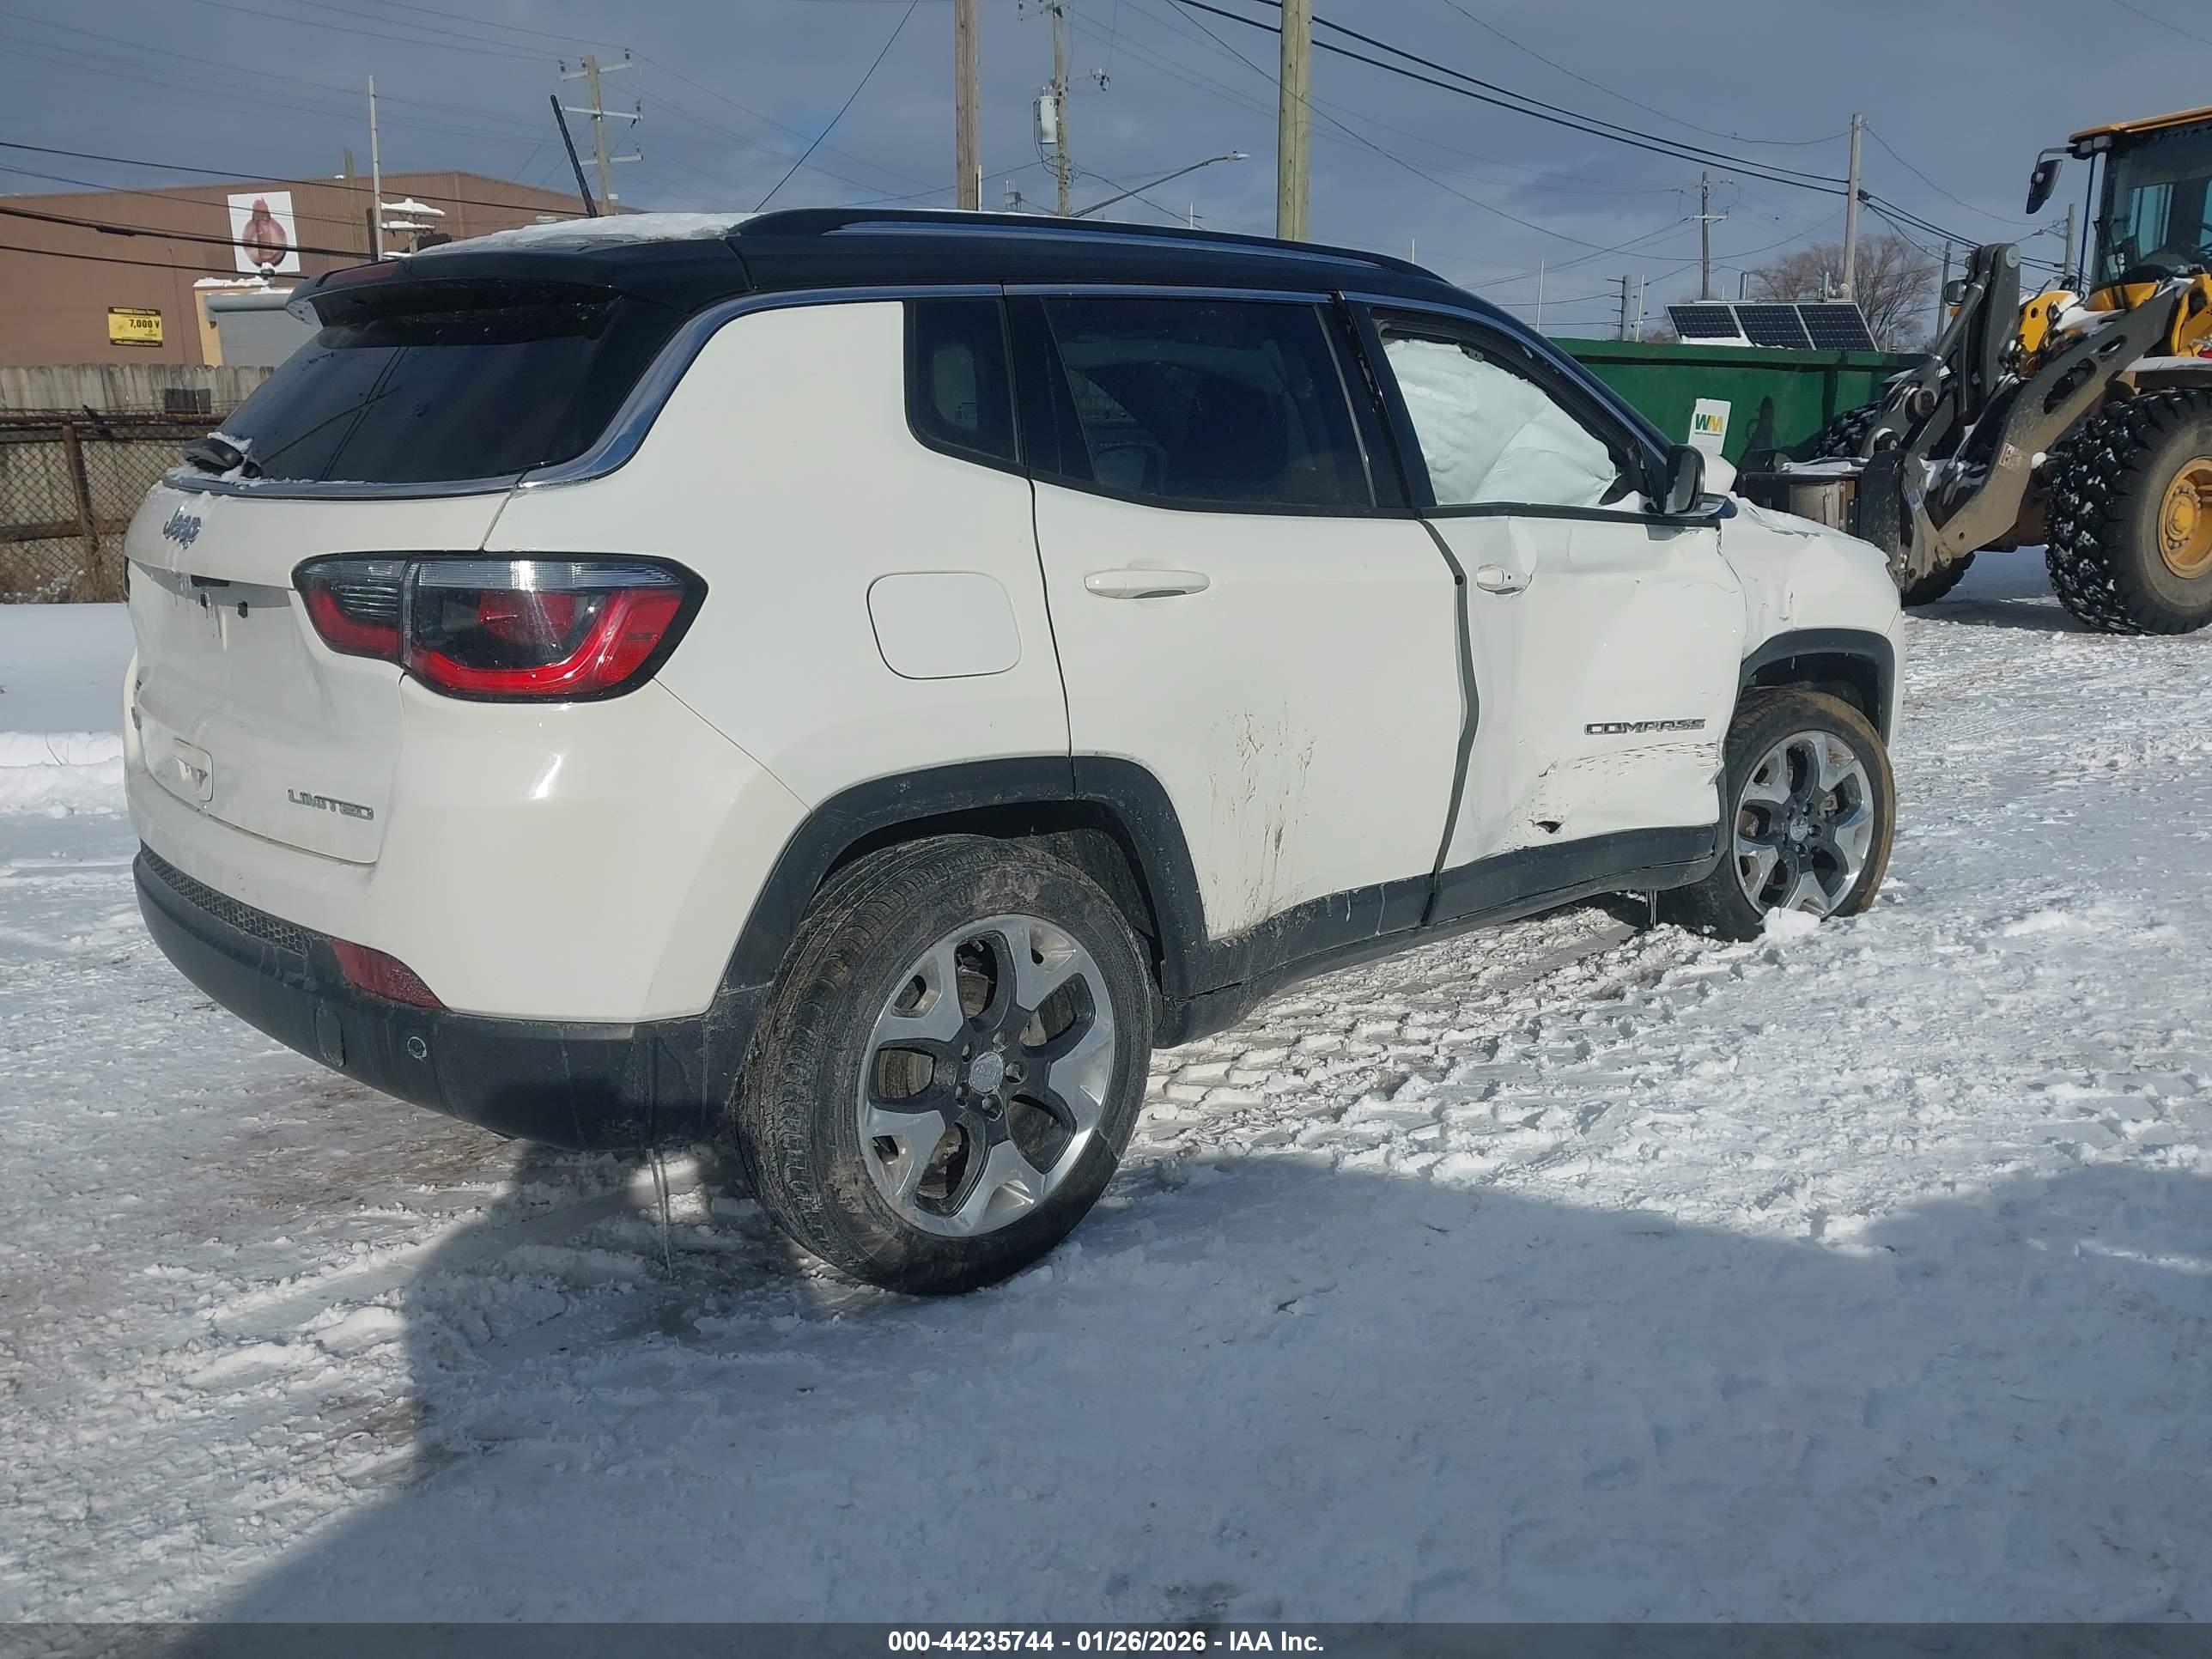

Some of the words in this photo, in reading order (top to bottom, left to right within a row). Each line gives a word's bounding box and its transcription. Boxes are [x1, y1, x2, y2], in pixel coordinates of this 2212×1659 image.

[129, 319, 153, 329] 7,000
[155, 319, 161, 329] V
[1695, 413, 1723, 433] WM
[162, 505, 202, 548] Jeep
[1583, 718, 1706, 736] COMPASS
[287, 788, 374, 821] LIMITED
